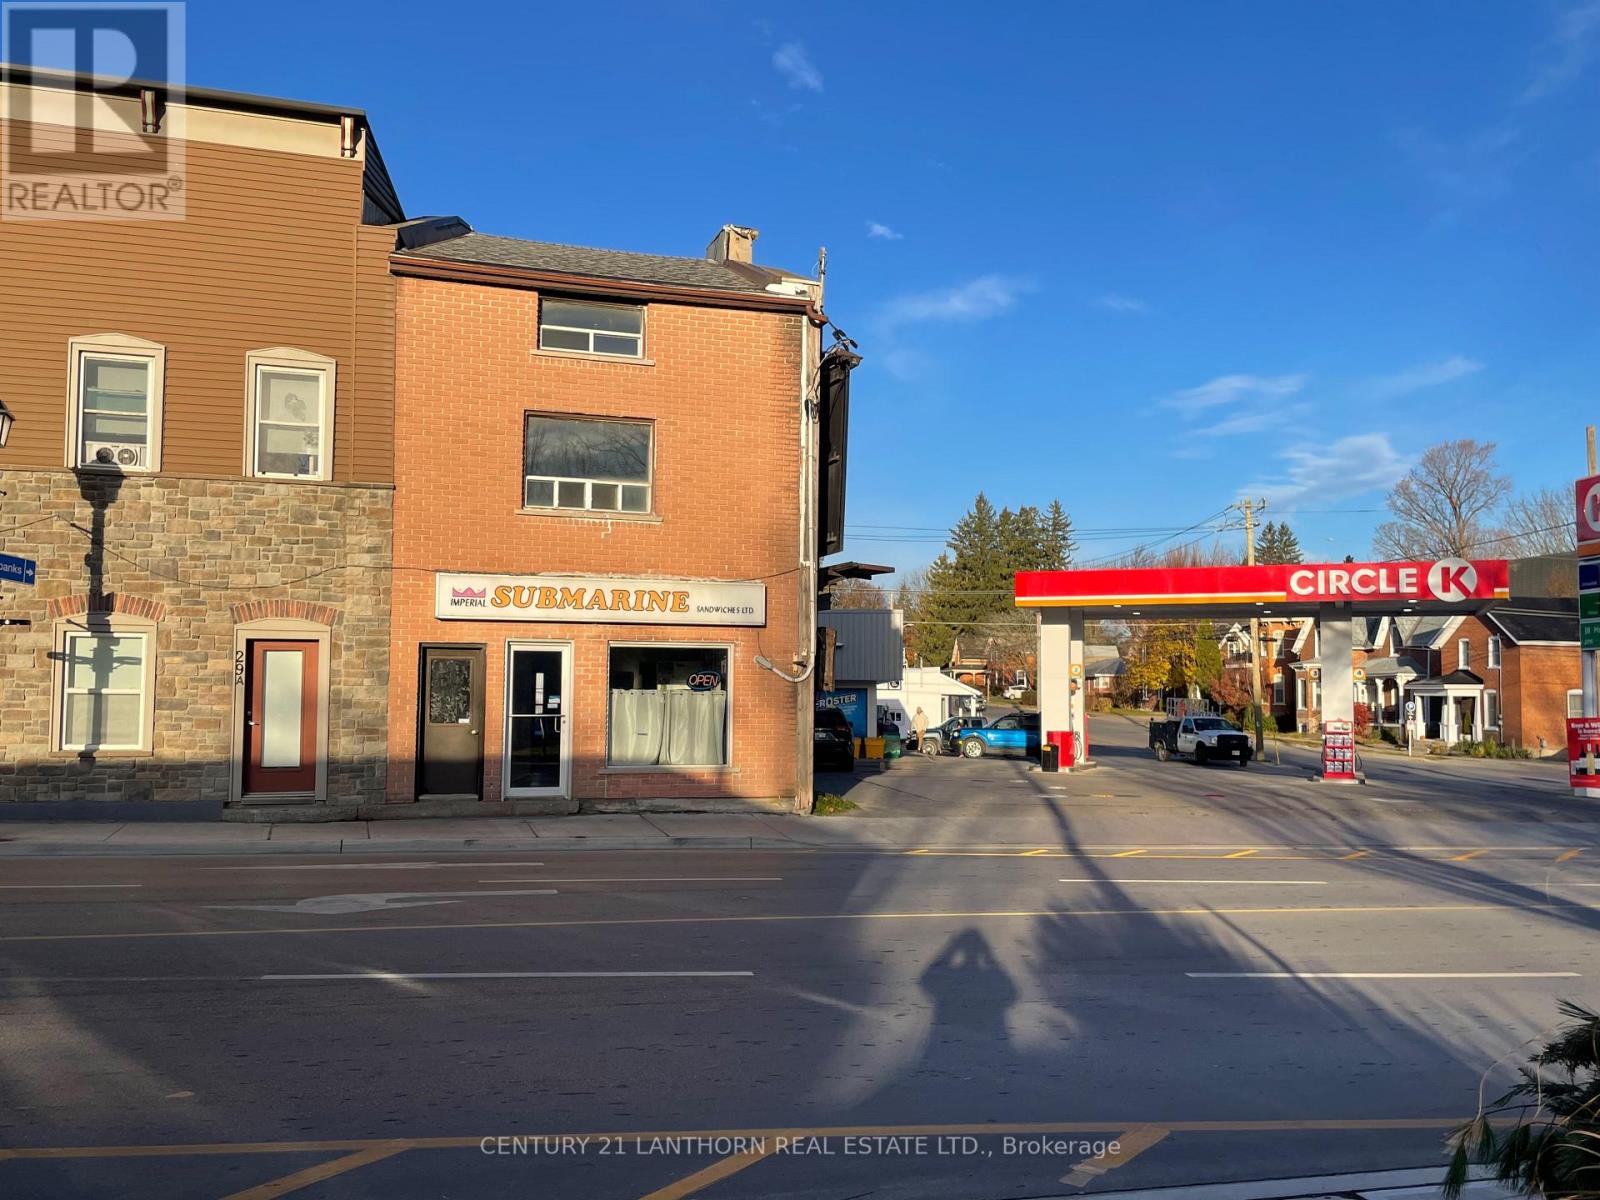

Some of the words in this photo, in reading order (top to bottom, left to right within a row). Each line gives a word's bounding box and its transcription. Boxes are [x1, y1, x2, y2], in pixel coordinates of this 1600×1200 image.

[1289, 568, 1418, 596] CIRCLE
[1441, 566, 1472, 598] K
[450, 598, 487, 608] IMPERIAL
[490, 585, 690, 612] SUBMARINE
[696, 605, 740, 614] SANDWICHES
[741, 606, 754, 615] LTD
[235, 650, 244, 686] 29A
[688, 674, 719, 686] OPEN
